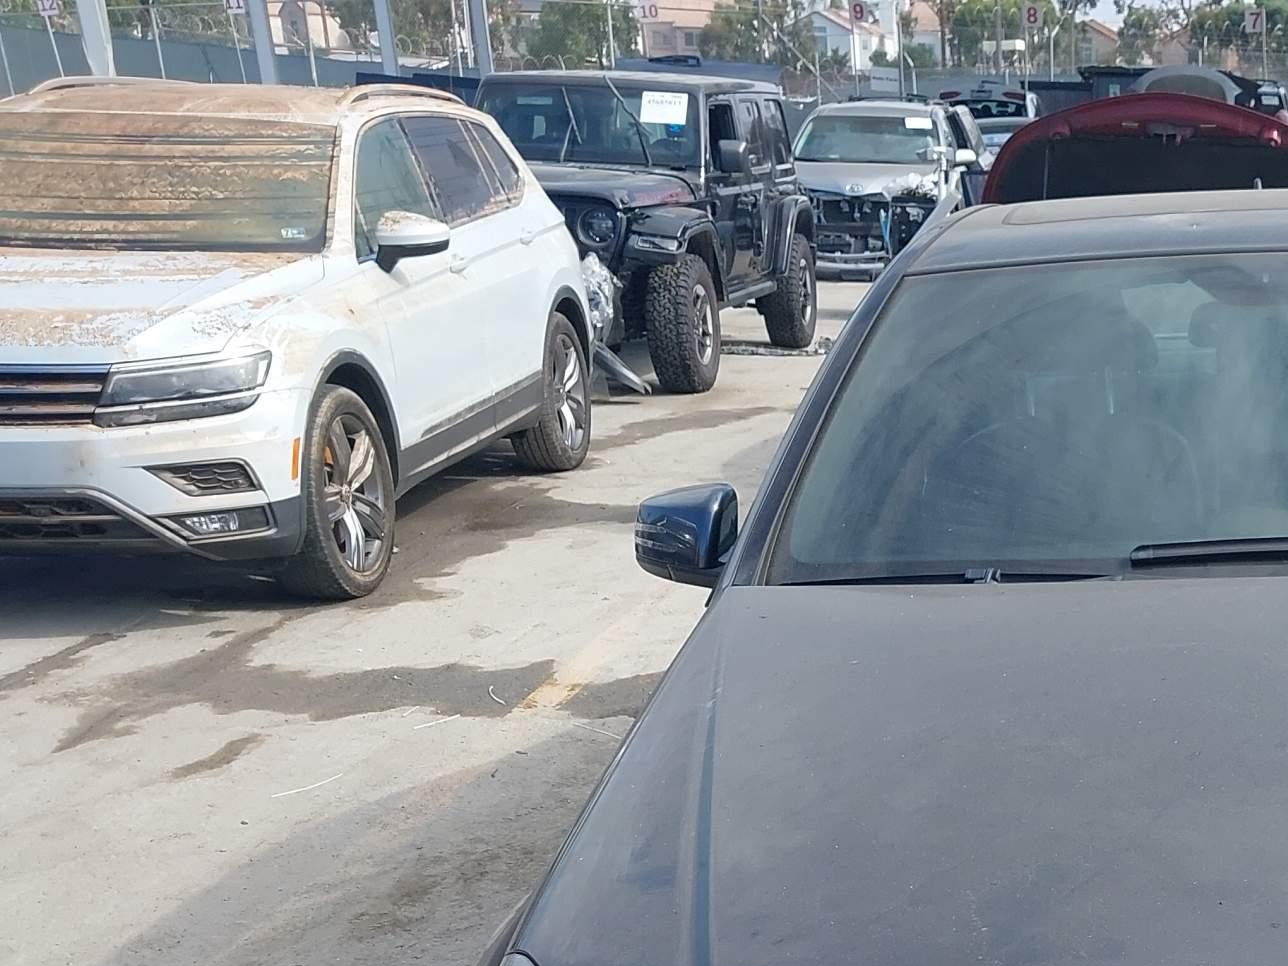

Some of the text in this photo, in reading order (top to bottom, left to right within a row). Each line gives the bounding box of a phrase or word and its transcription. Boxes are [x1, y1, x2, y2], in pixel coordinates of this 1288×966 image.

[640, 5, 658, 19] 10
[853, 3, 865, 20] 9
[1026, 7, 1038, 25] 8
[1250, 12, 1262, 30] 7
